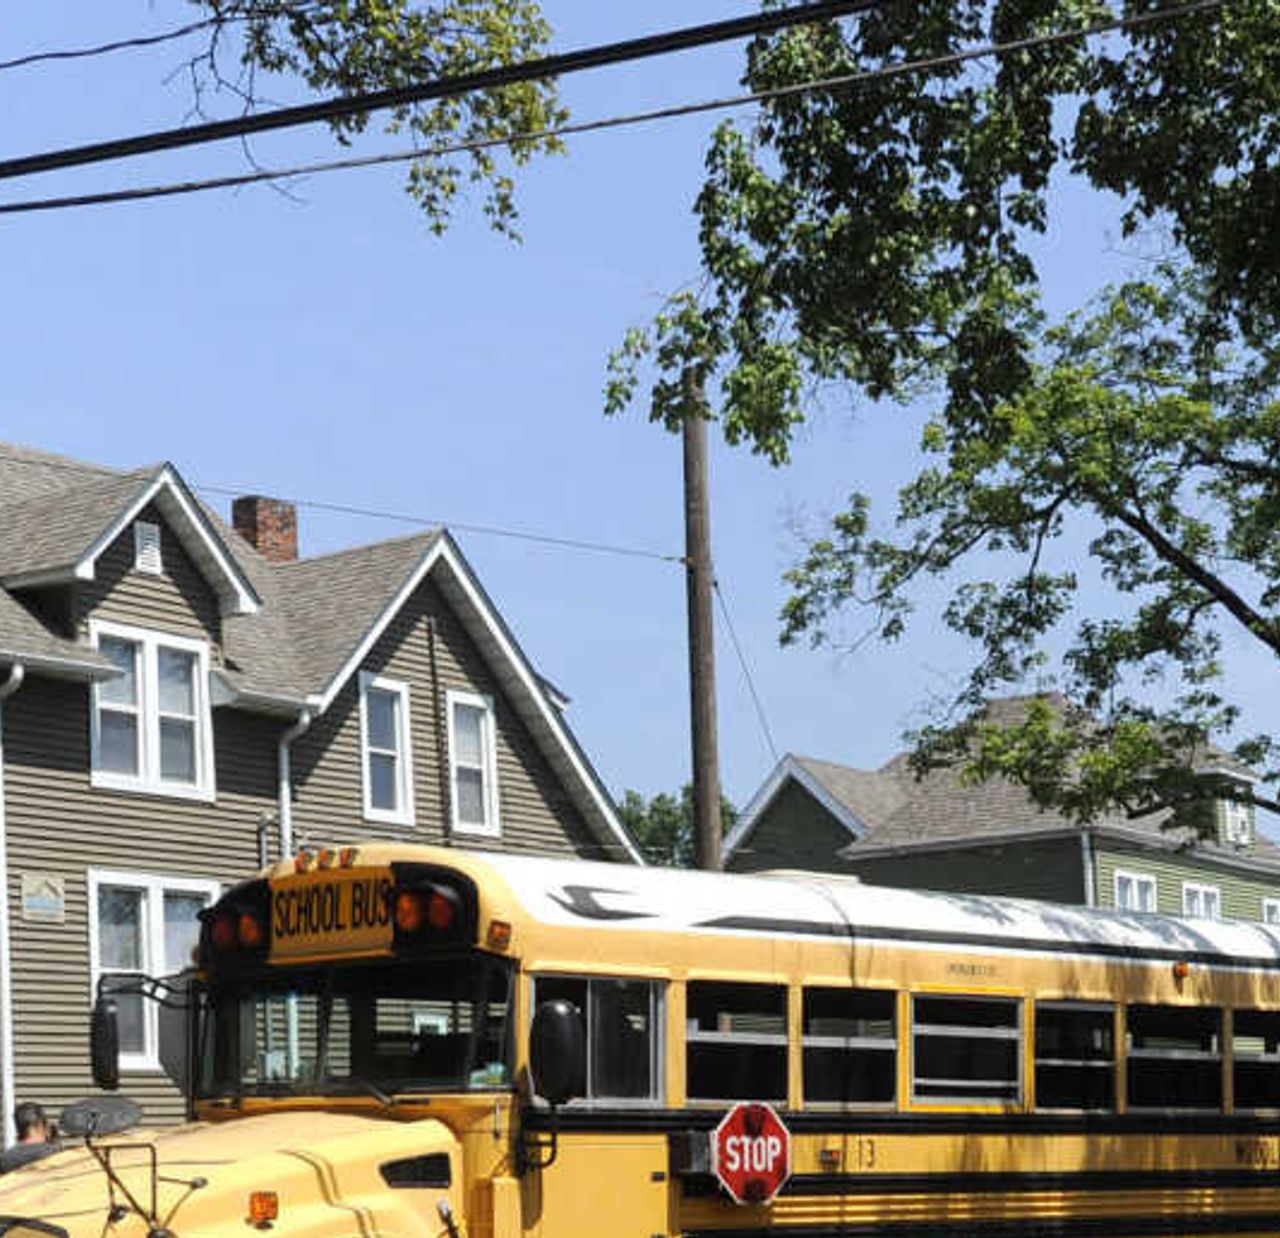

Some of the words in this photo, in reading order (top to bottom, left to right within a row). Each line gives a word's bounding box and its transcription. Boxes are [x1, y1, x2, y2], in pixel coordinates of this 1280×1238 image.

[275, 883, 347, 937] SCHOOL
[352, 879, 391, 928] BUS
[725, 1136, 782, 1172] STOP
